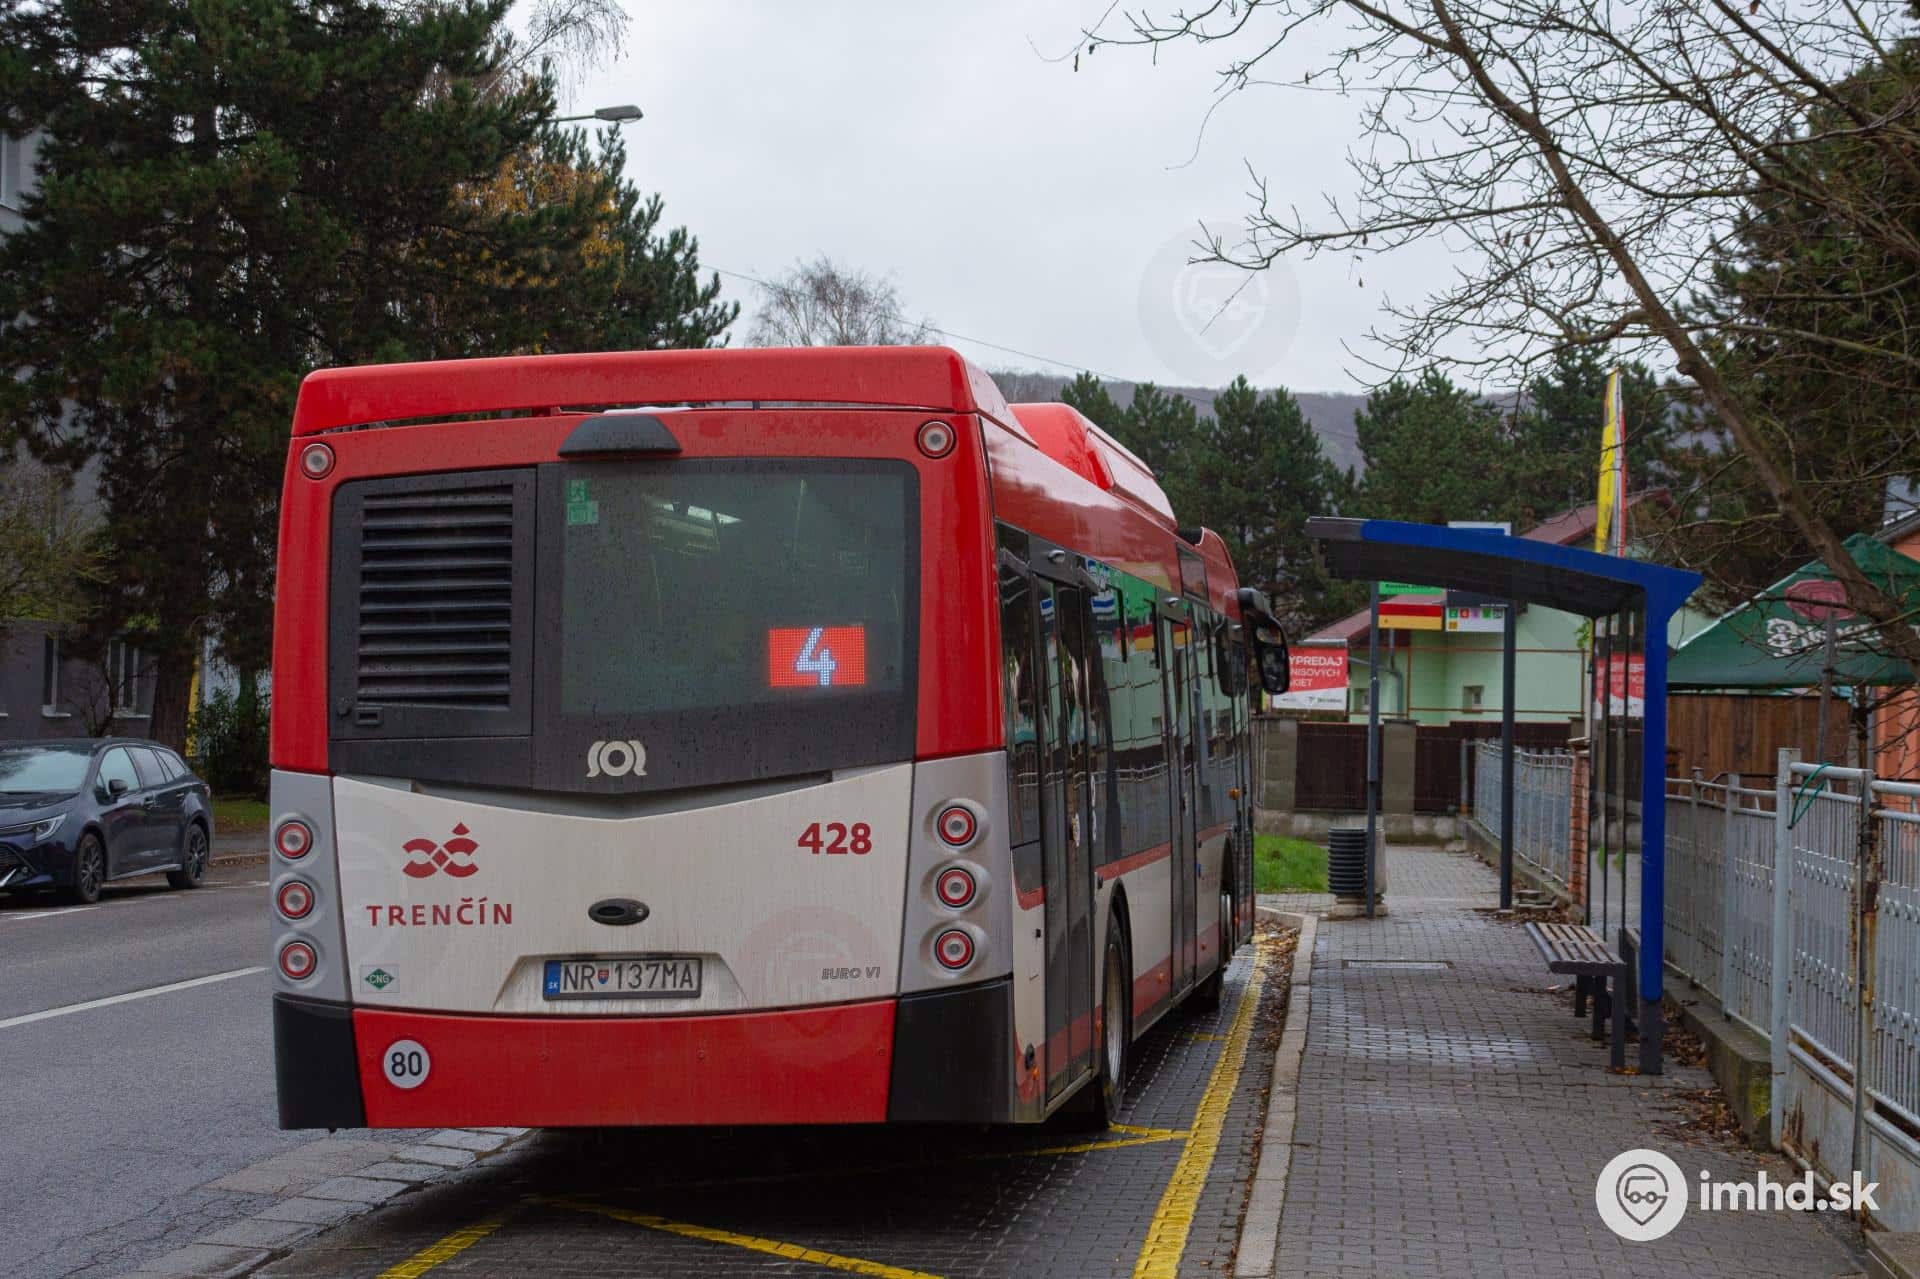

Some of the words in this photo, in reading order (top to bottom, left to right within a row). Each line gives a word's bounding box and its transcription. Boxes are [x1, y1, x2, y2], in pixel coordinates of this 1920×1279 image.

[796, 628, 837, 687] 4
[1289, 656, 1343, 666] YPREDAJ
[1290, 667, 1340, 677] NISOVÝCH
[1291, 678, 1313, 687] KIET
[798, 822, 872, 855] 428
[366, 896, 512, 927] TRENČÍN
[369, 974, 390, 984] CNG
[563, 964, 596, 991] NR
[614, 962, 694, 989] 137MA
[822, 968, 861, 981] EURO
[866, 966, 881, 979] VI
[391, 1052, 423, 1078] 80
